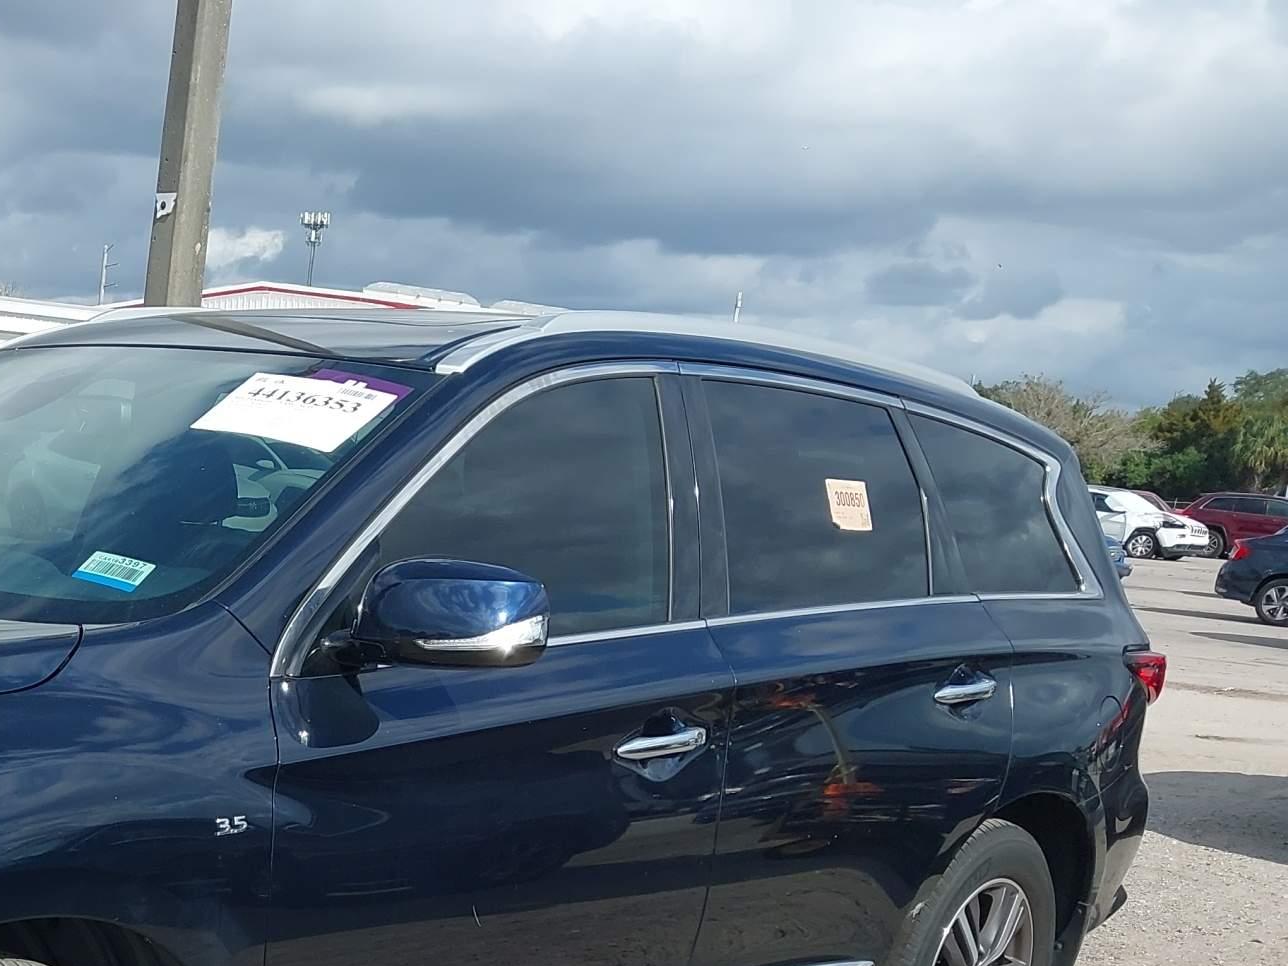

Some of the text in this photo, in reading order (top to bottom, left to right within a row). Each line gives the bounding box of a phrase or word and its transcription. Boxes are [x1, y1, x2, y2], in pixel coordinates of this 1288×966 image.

[247, 386, 363, 414] 44136353
[834, 490, 866, 508] 300850
[215, 816, 248, 836] 3.5
